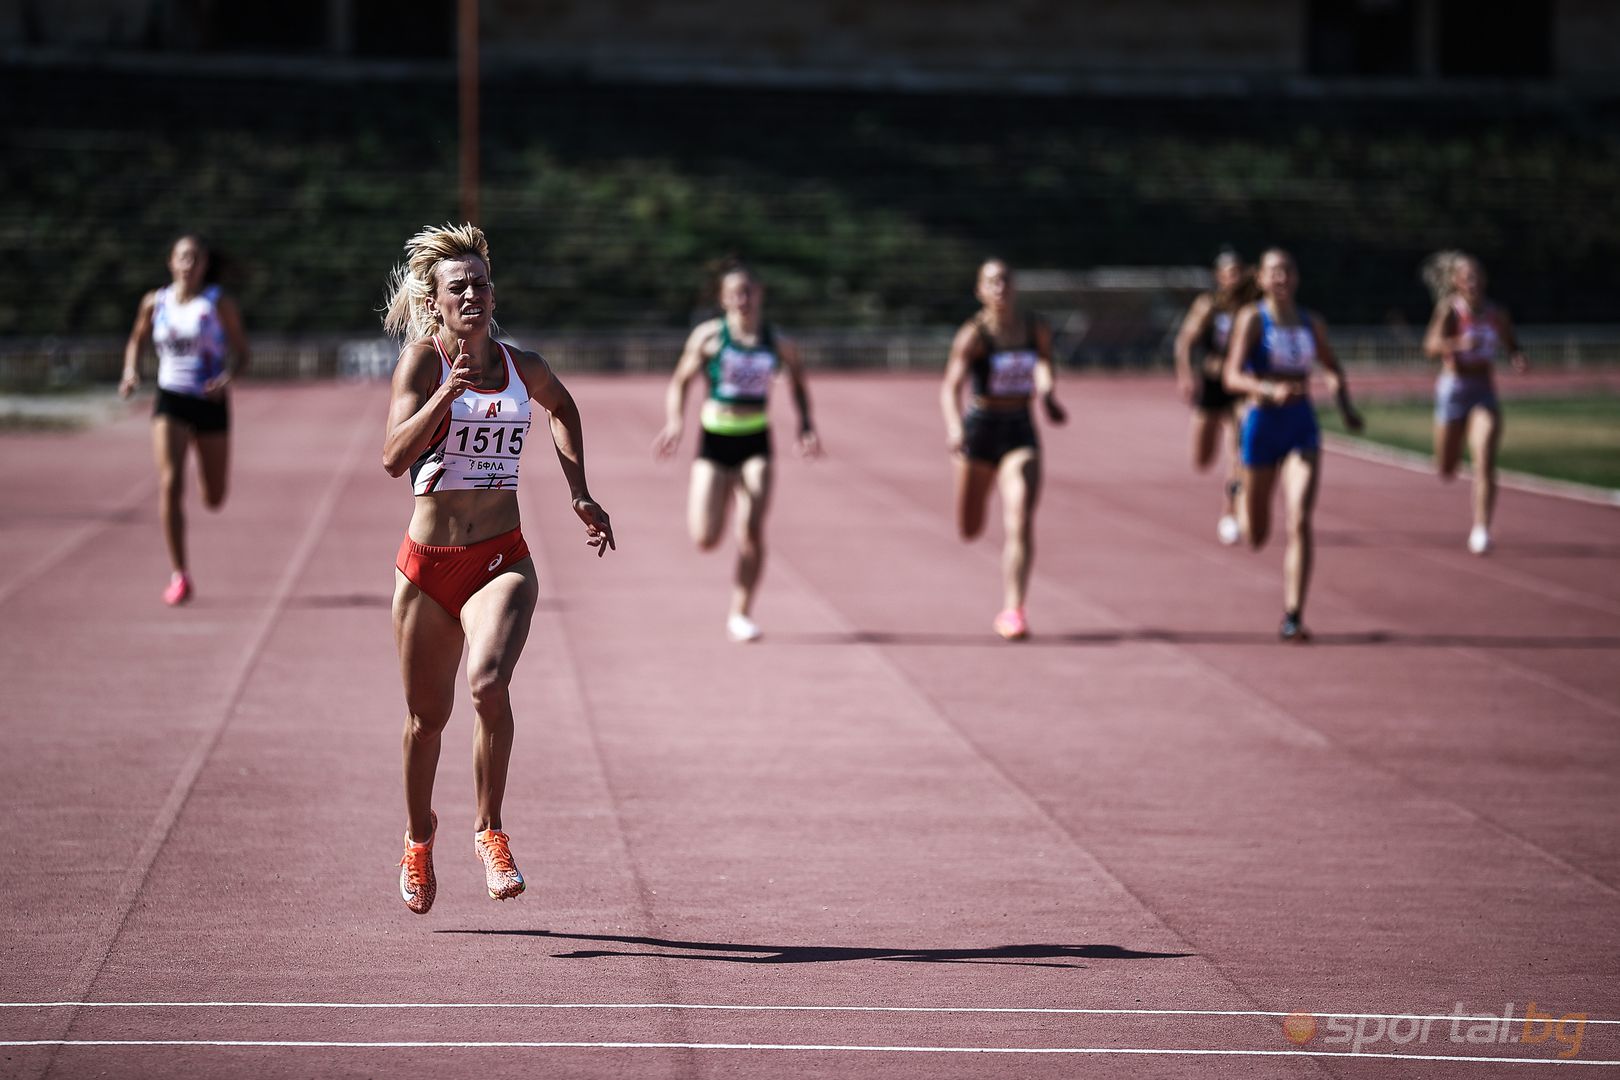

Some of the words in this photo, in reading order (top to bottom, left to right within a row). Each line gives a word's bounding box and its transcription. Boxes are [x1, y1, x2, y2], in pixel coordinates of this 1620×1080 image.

[485, 400, 502, 419] A1
[456, 426, 524, 455] 1515
[477, 461, 504, 471] БФЛА
